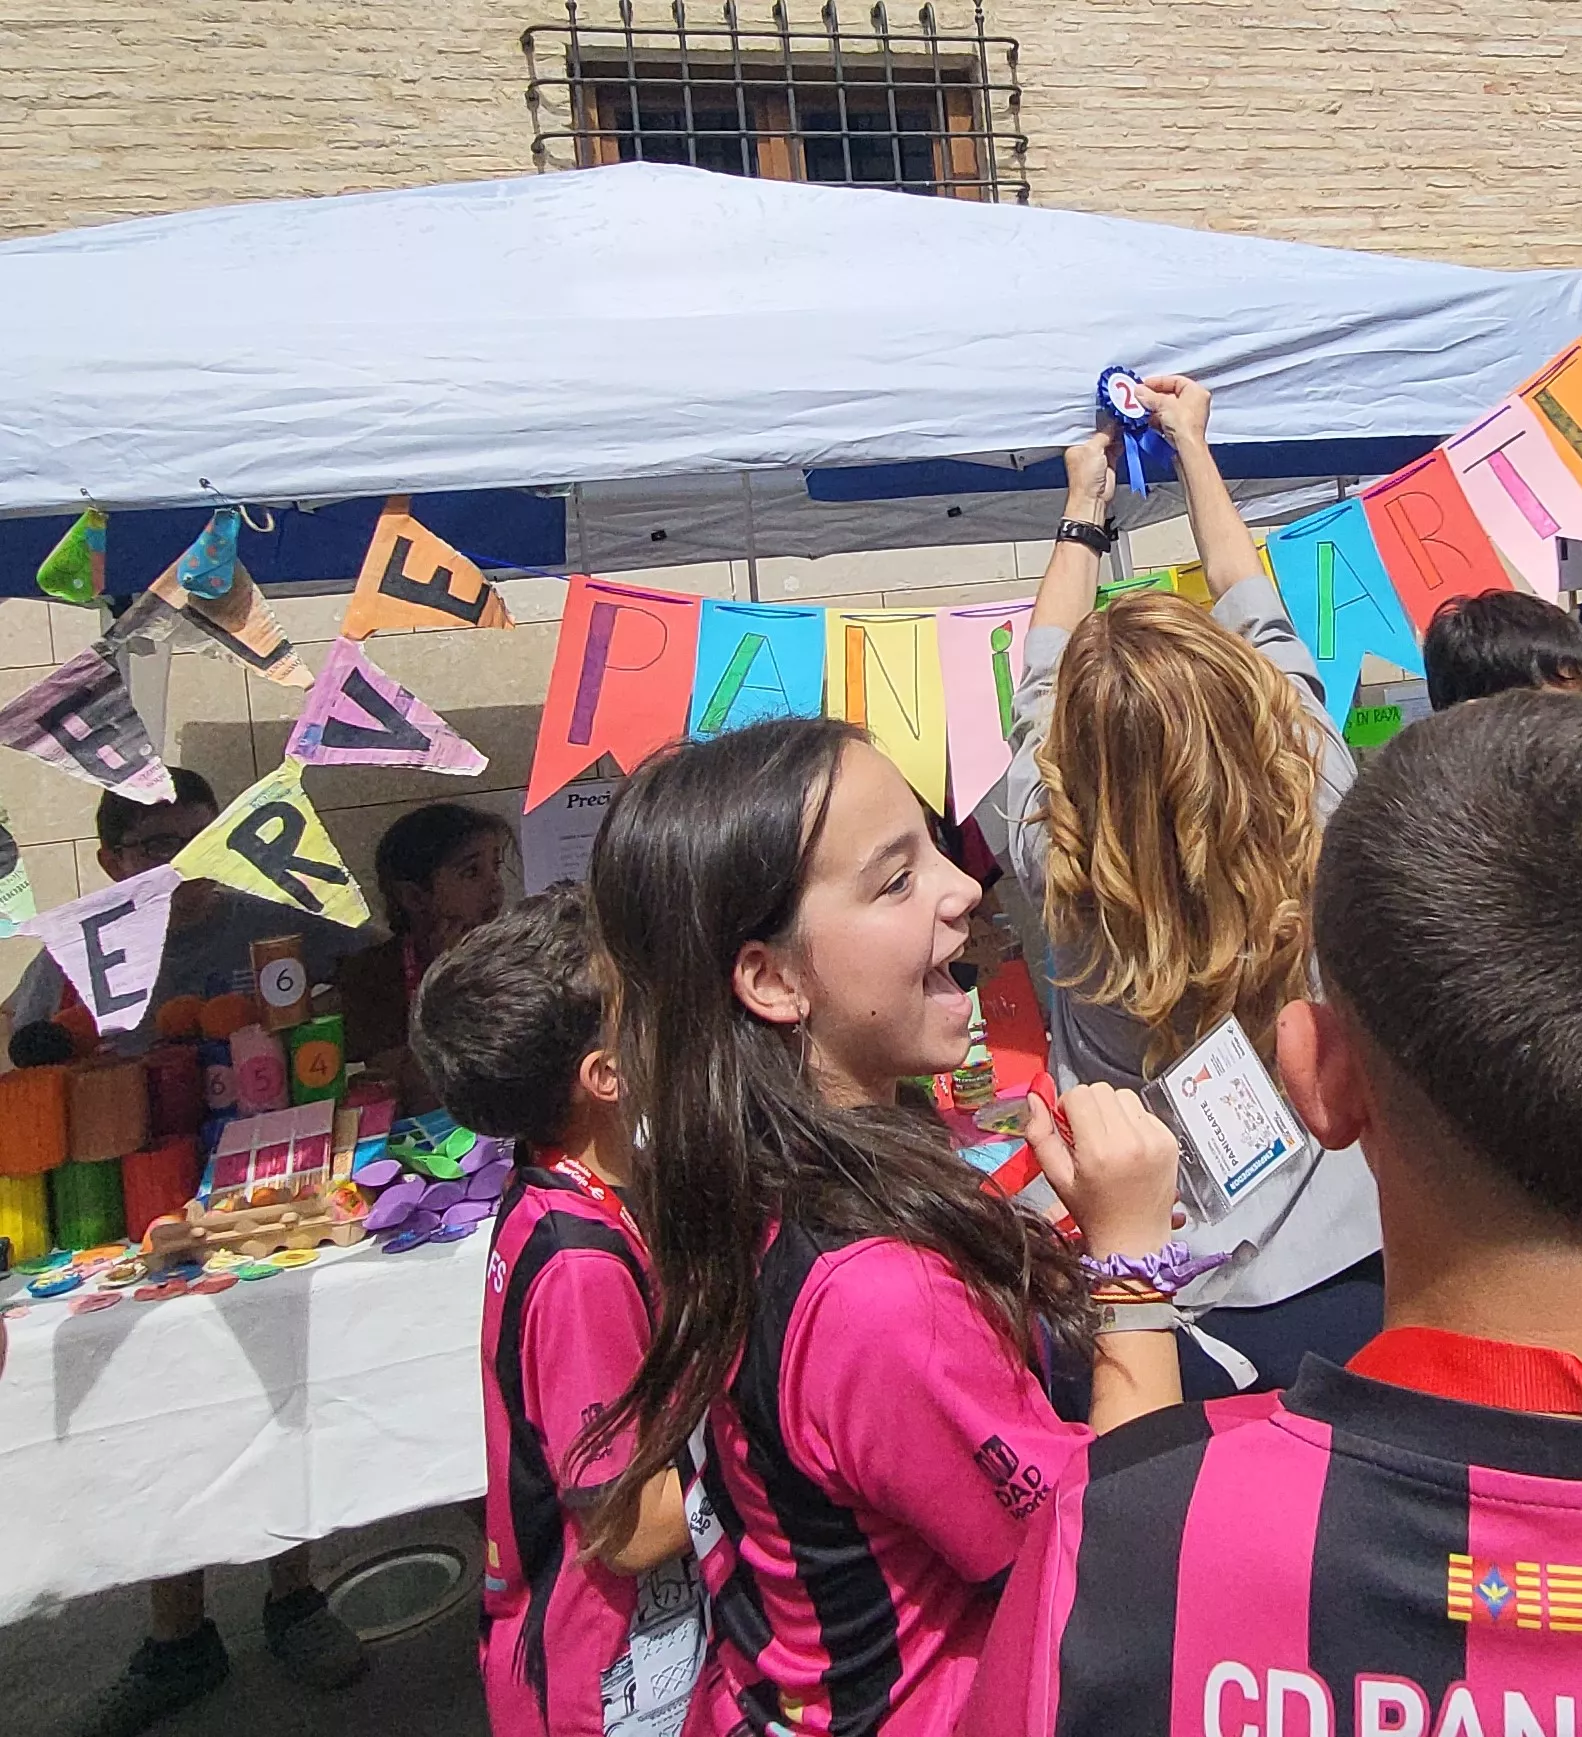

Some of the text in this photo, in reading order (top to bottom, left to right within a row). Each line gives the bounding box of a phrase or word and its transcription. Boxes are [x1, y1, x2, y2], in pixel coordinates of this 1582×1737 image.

[1115, 382, 1139, 410] 2
[276, 968, 294, 992] 6
[309, 1053, 327, 1076] 4
[1201, 1100, 1239, 1167] PANICEARTE
[995, 1465, 1041, 1508] DAD
[690, 1511, 711, 1530] DAD
[1203, 1661, 1327, 1737] CD
